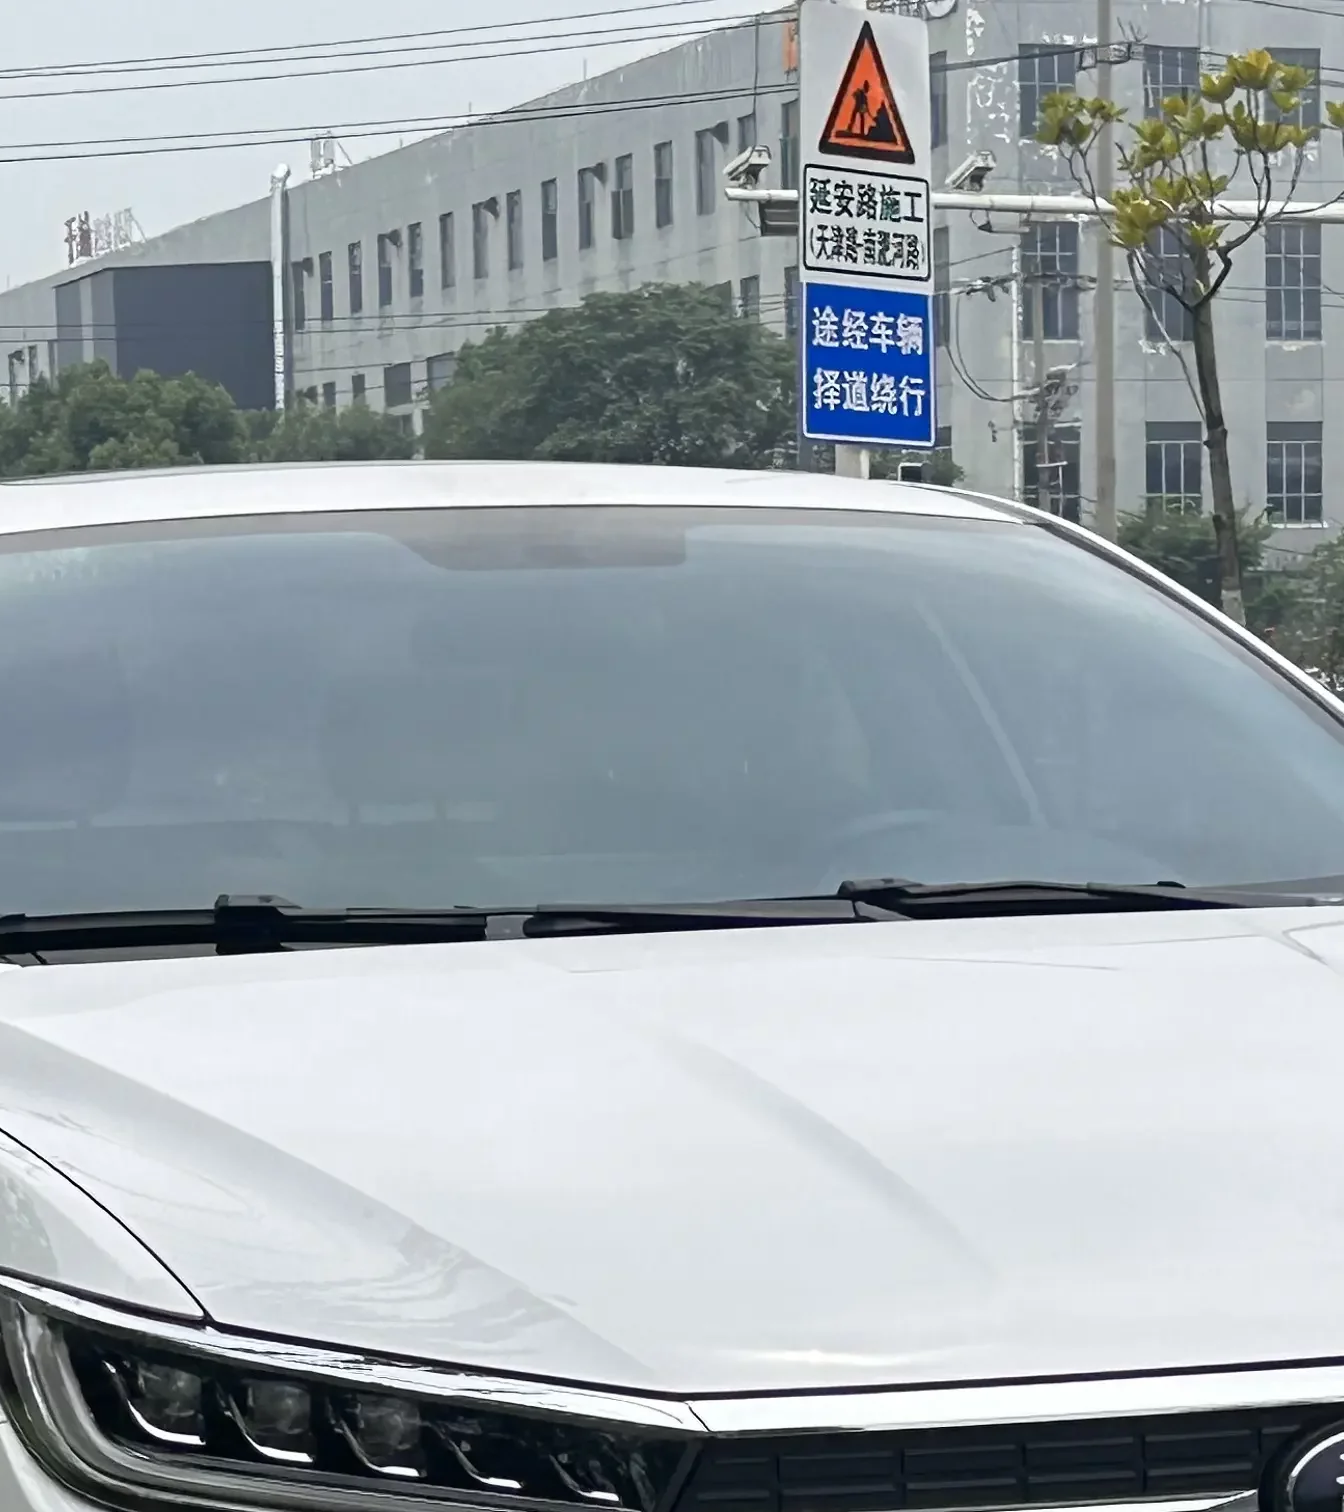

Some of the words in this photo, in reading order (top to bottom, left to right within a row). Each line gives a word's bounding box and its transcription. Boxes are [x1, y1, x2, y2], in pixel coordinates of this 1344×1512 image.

[809, 177, 924, 222] 延安路施工
[812, 305, 923, 355] 途经车辆
[813, 367, 925, 416] 择道绕行
